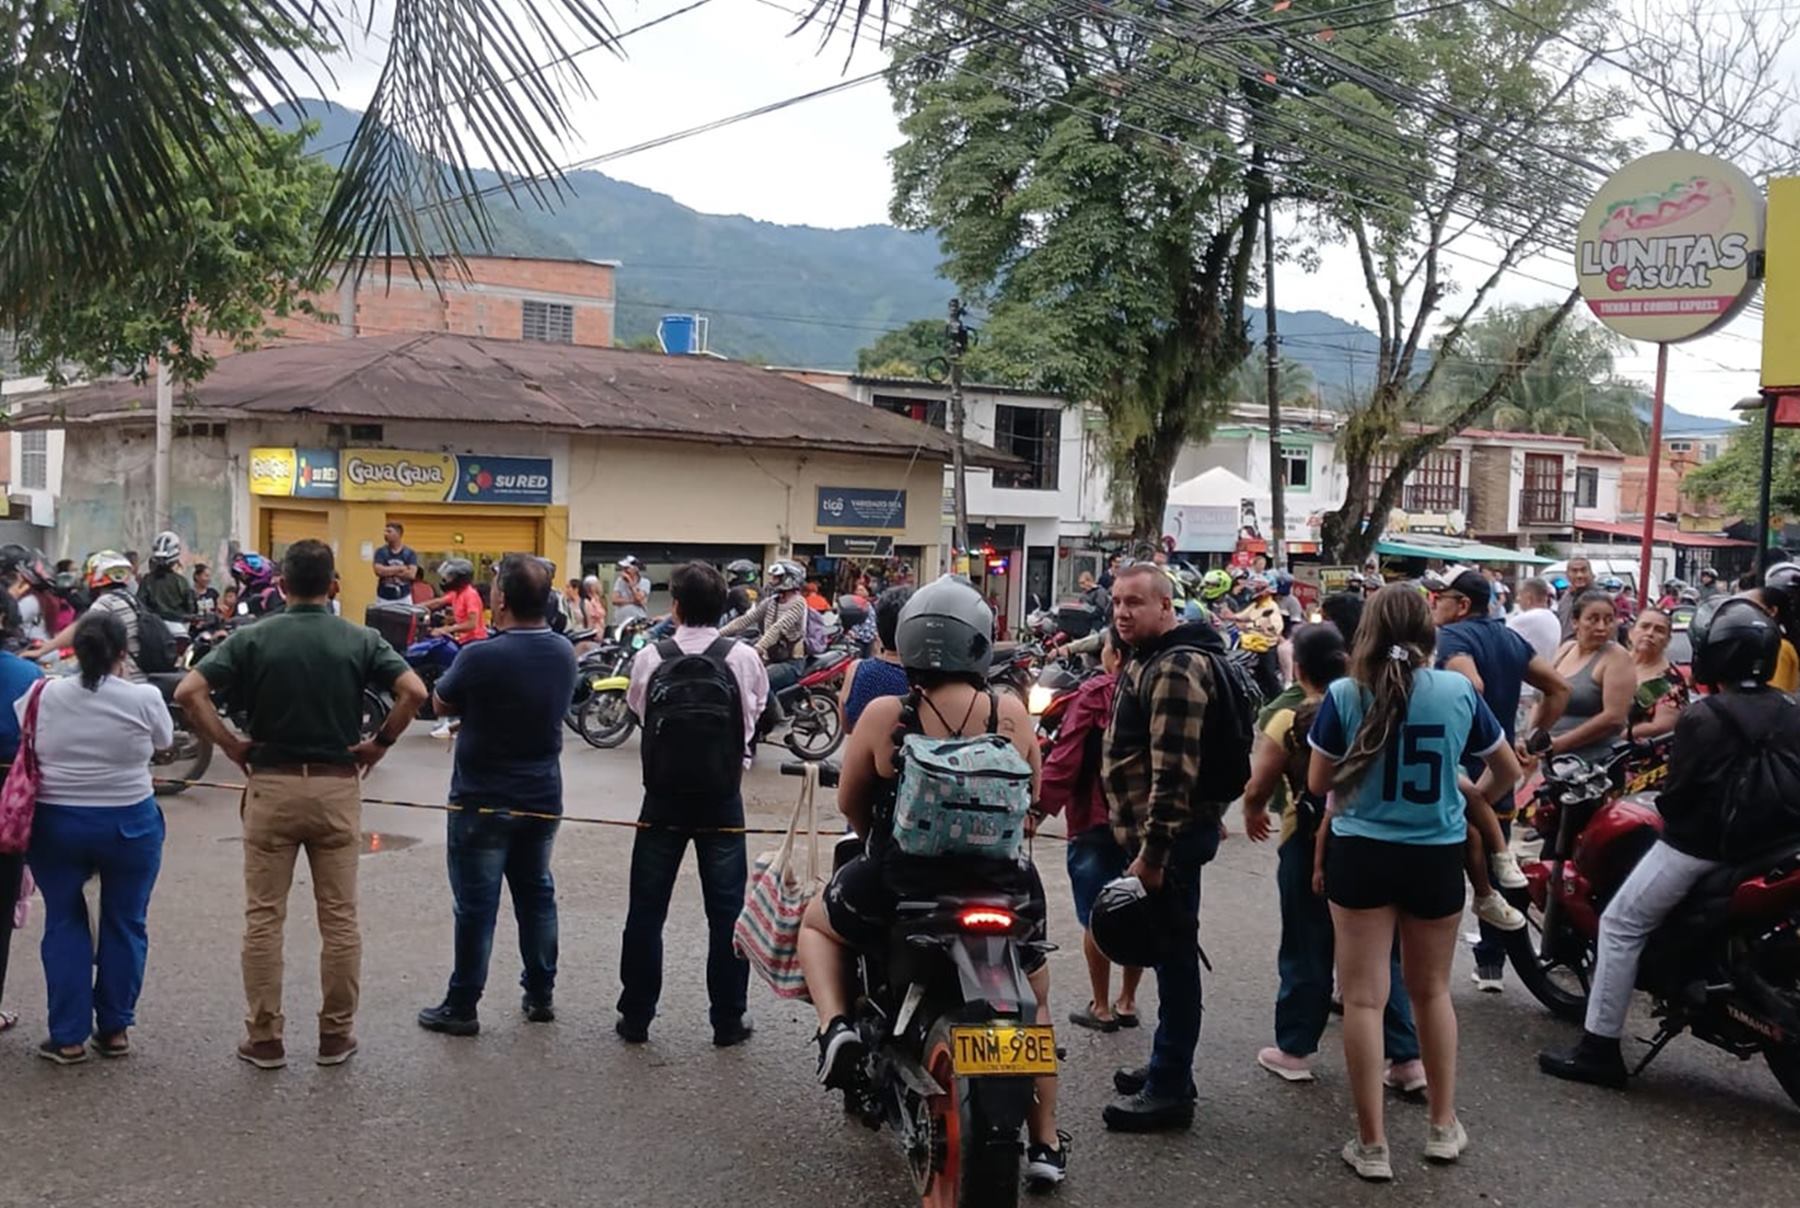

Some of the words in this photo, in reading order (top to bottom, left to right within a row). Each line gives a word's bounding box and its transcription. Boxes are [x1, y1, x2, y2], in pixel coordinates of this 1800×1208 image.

[1581, 233, 1749, 276] LUNITAS
[1606, 265, 1711, 292] CASUAL
[495, 475, 515, 488] SU
[516, 475, 548, 488] RED
[1383, 724, 1445, 804] 15
[957, 1035, 1000, 1063] TNM
[1010, 1035, 1052, 1063] 98E
